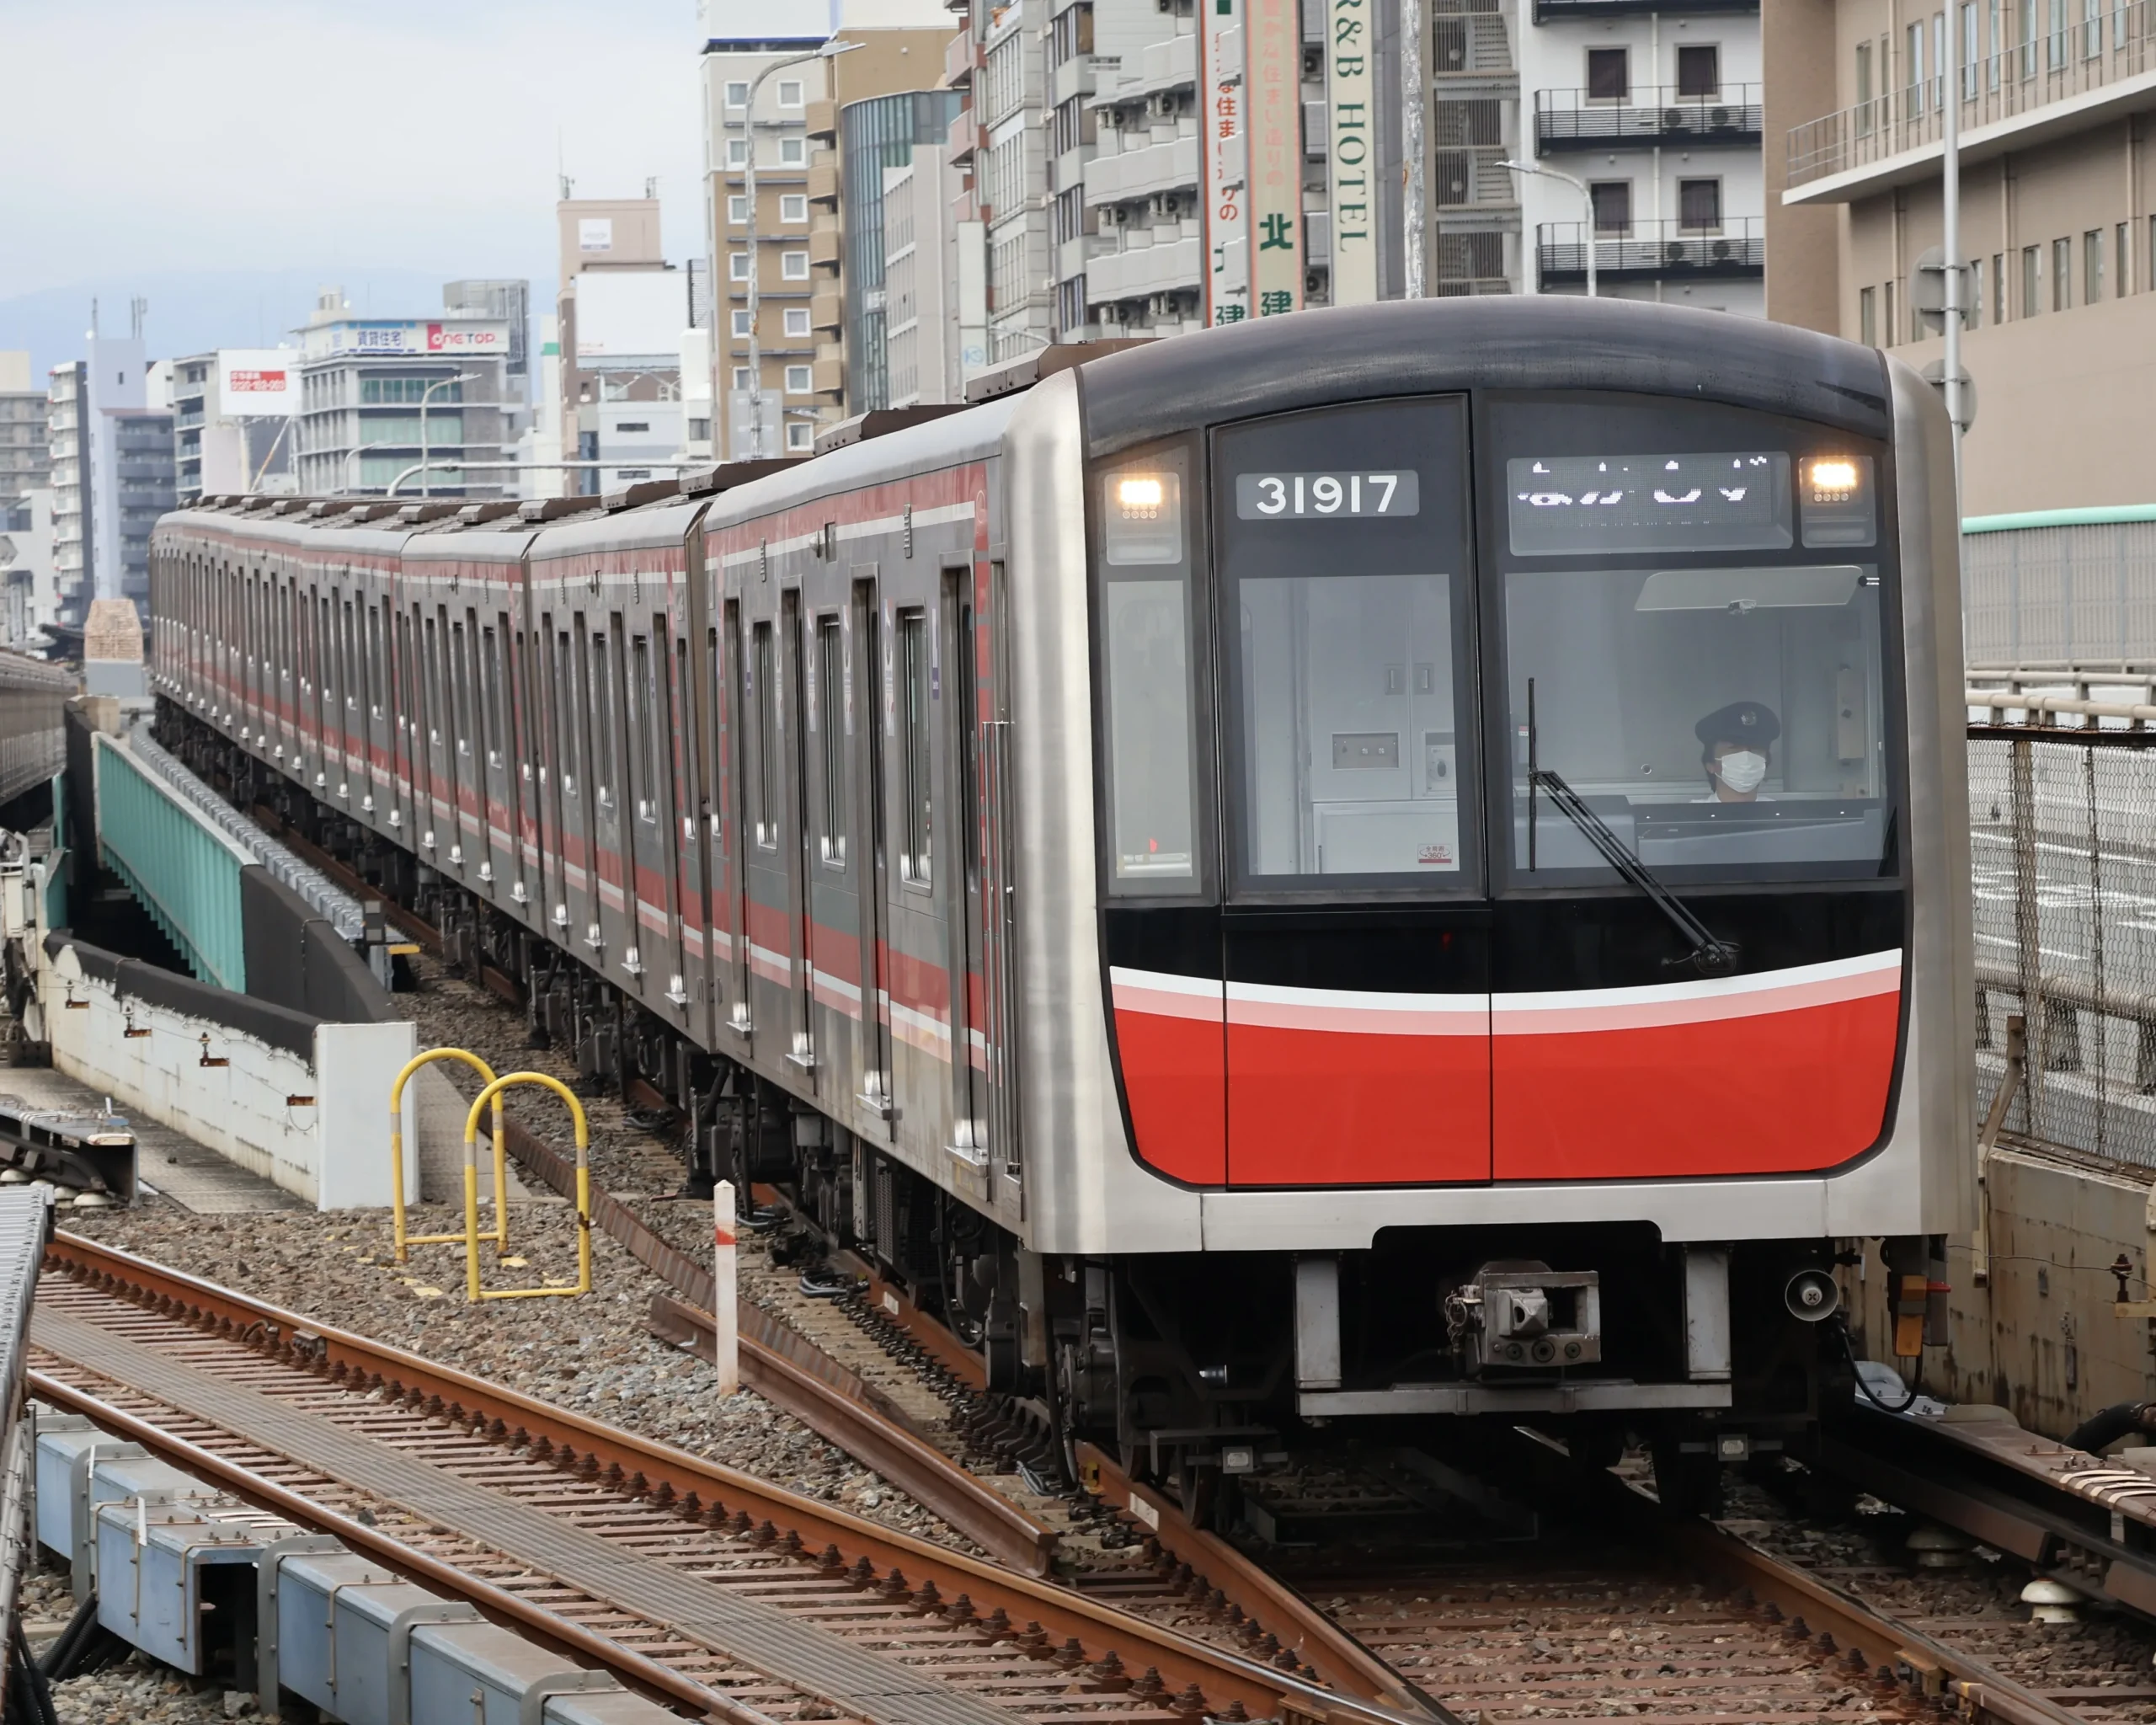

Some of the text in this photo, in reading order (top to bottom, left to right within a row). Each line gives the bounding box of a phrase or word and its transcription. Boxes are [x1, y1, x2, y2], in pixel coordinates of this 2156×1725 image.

[1337, 100, 1368, 253] HOTEL
[357, 330, 402, 347] 賃貸住宅
[465, 333, 496, 344] TOP
[1256, 474, 1398, 515] 31917
